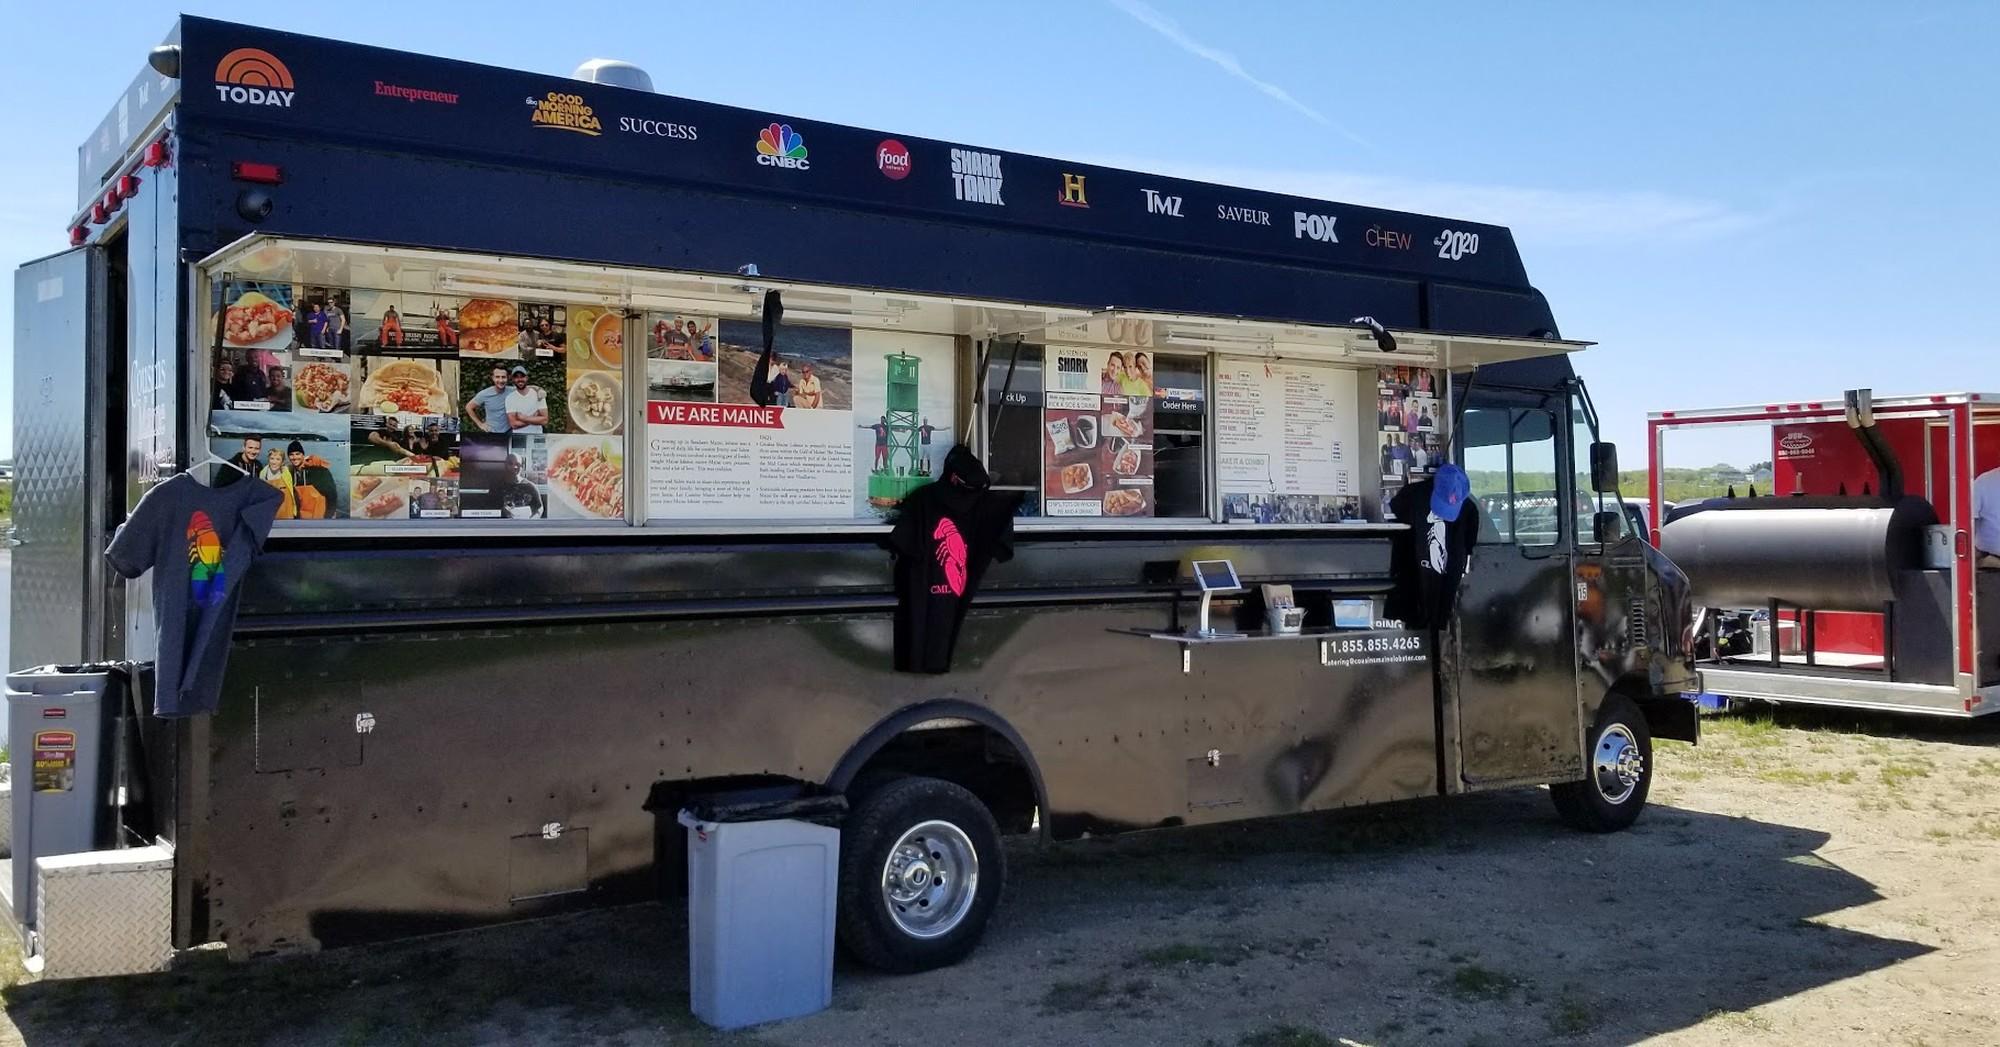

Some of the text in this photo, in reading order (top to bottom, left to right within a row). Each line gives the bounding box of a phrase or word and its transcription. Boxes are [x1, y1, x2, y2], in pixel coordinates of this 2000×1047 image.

[215, 85, 295, 108] TODAY
[374, 80, 459, 104] Entrepreneur
[547, 92, 583, 105] GOOD
[538, 100, 593, 116] MORNING
[532, 109, 602, 130] AMERICA
[620, 117, 698, 141] SUCCESS
[756, 154, 810, 170] CNBC
[879, 148, 909, 169] food
[951, 148, 1002, 178] SHARK
[952, 172, 1005, 206] TANK
[1140, 188, 1185, 217] TMZ
[1217, 205, 1271, 226] SAVEUR
[1294, 211, 1339, 244] FOX
[1365, 228, 1412, 250] CHEW
[1058, 357, 1088, 373] SHARK
[1016, 393, 1027, 404] Up
[1162, 400, 1197, 411] Order Here
[658, 405, 774, 424] WE ARE MAINE
[930, 585, 951, 594] CML
[1331, 637, 1420, 653] 1.855.855.4265
